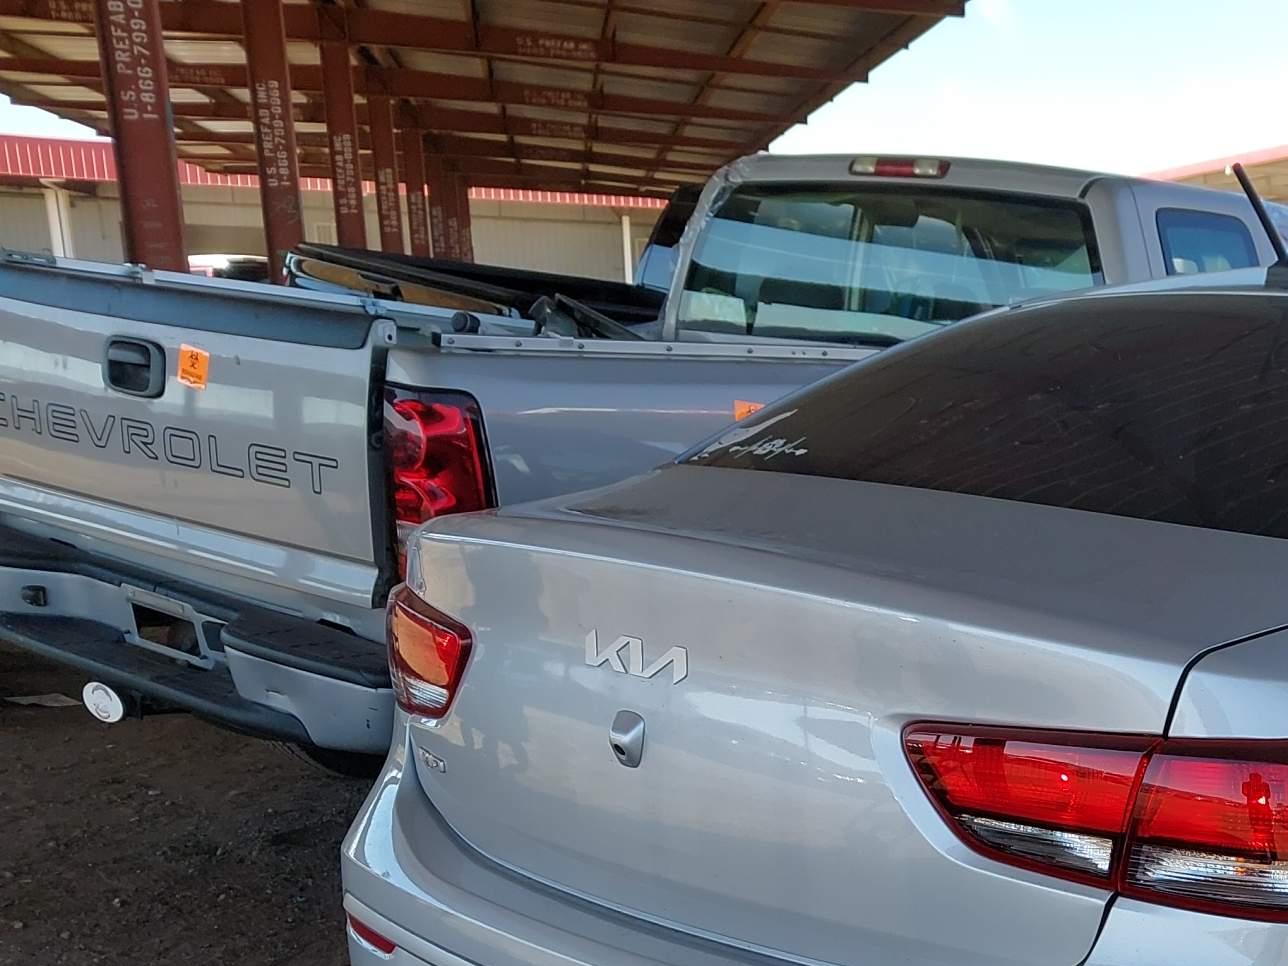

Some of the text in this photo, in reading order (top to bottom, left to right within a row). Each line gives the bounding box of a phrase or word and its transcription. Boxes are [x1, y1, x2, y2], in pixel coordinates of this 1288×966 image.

[107, 0, 139, 119] U.S. PREFAB
[258, 108, 275, 157] PREFAB
[0, 391, 339, 495] HEVROLET
[584, 628, 689, 686] KIA
